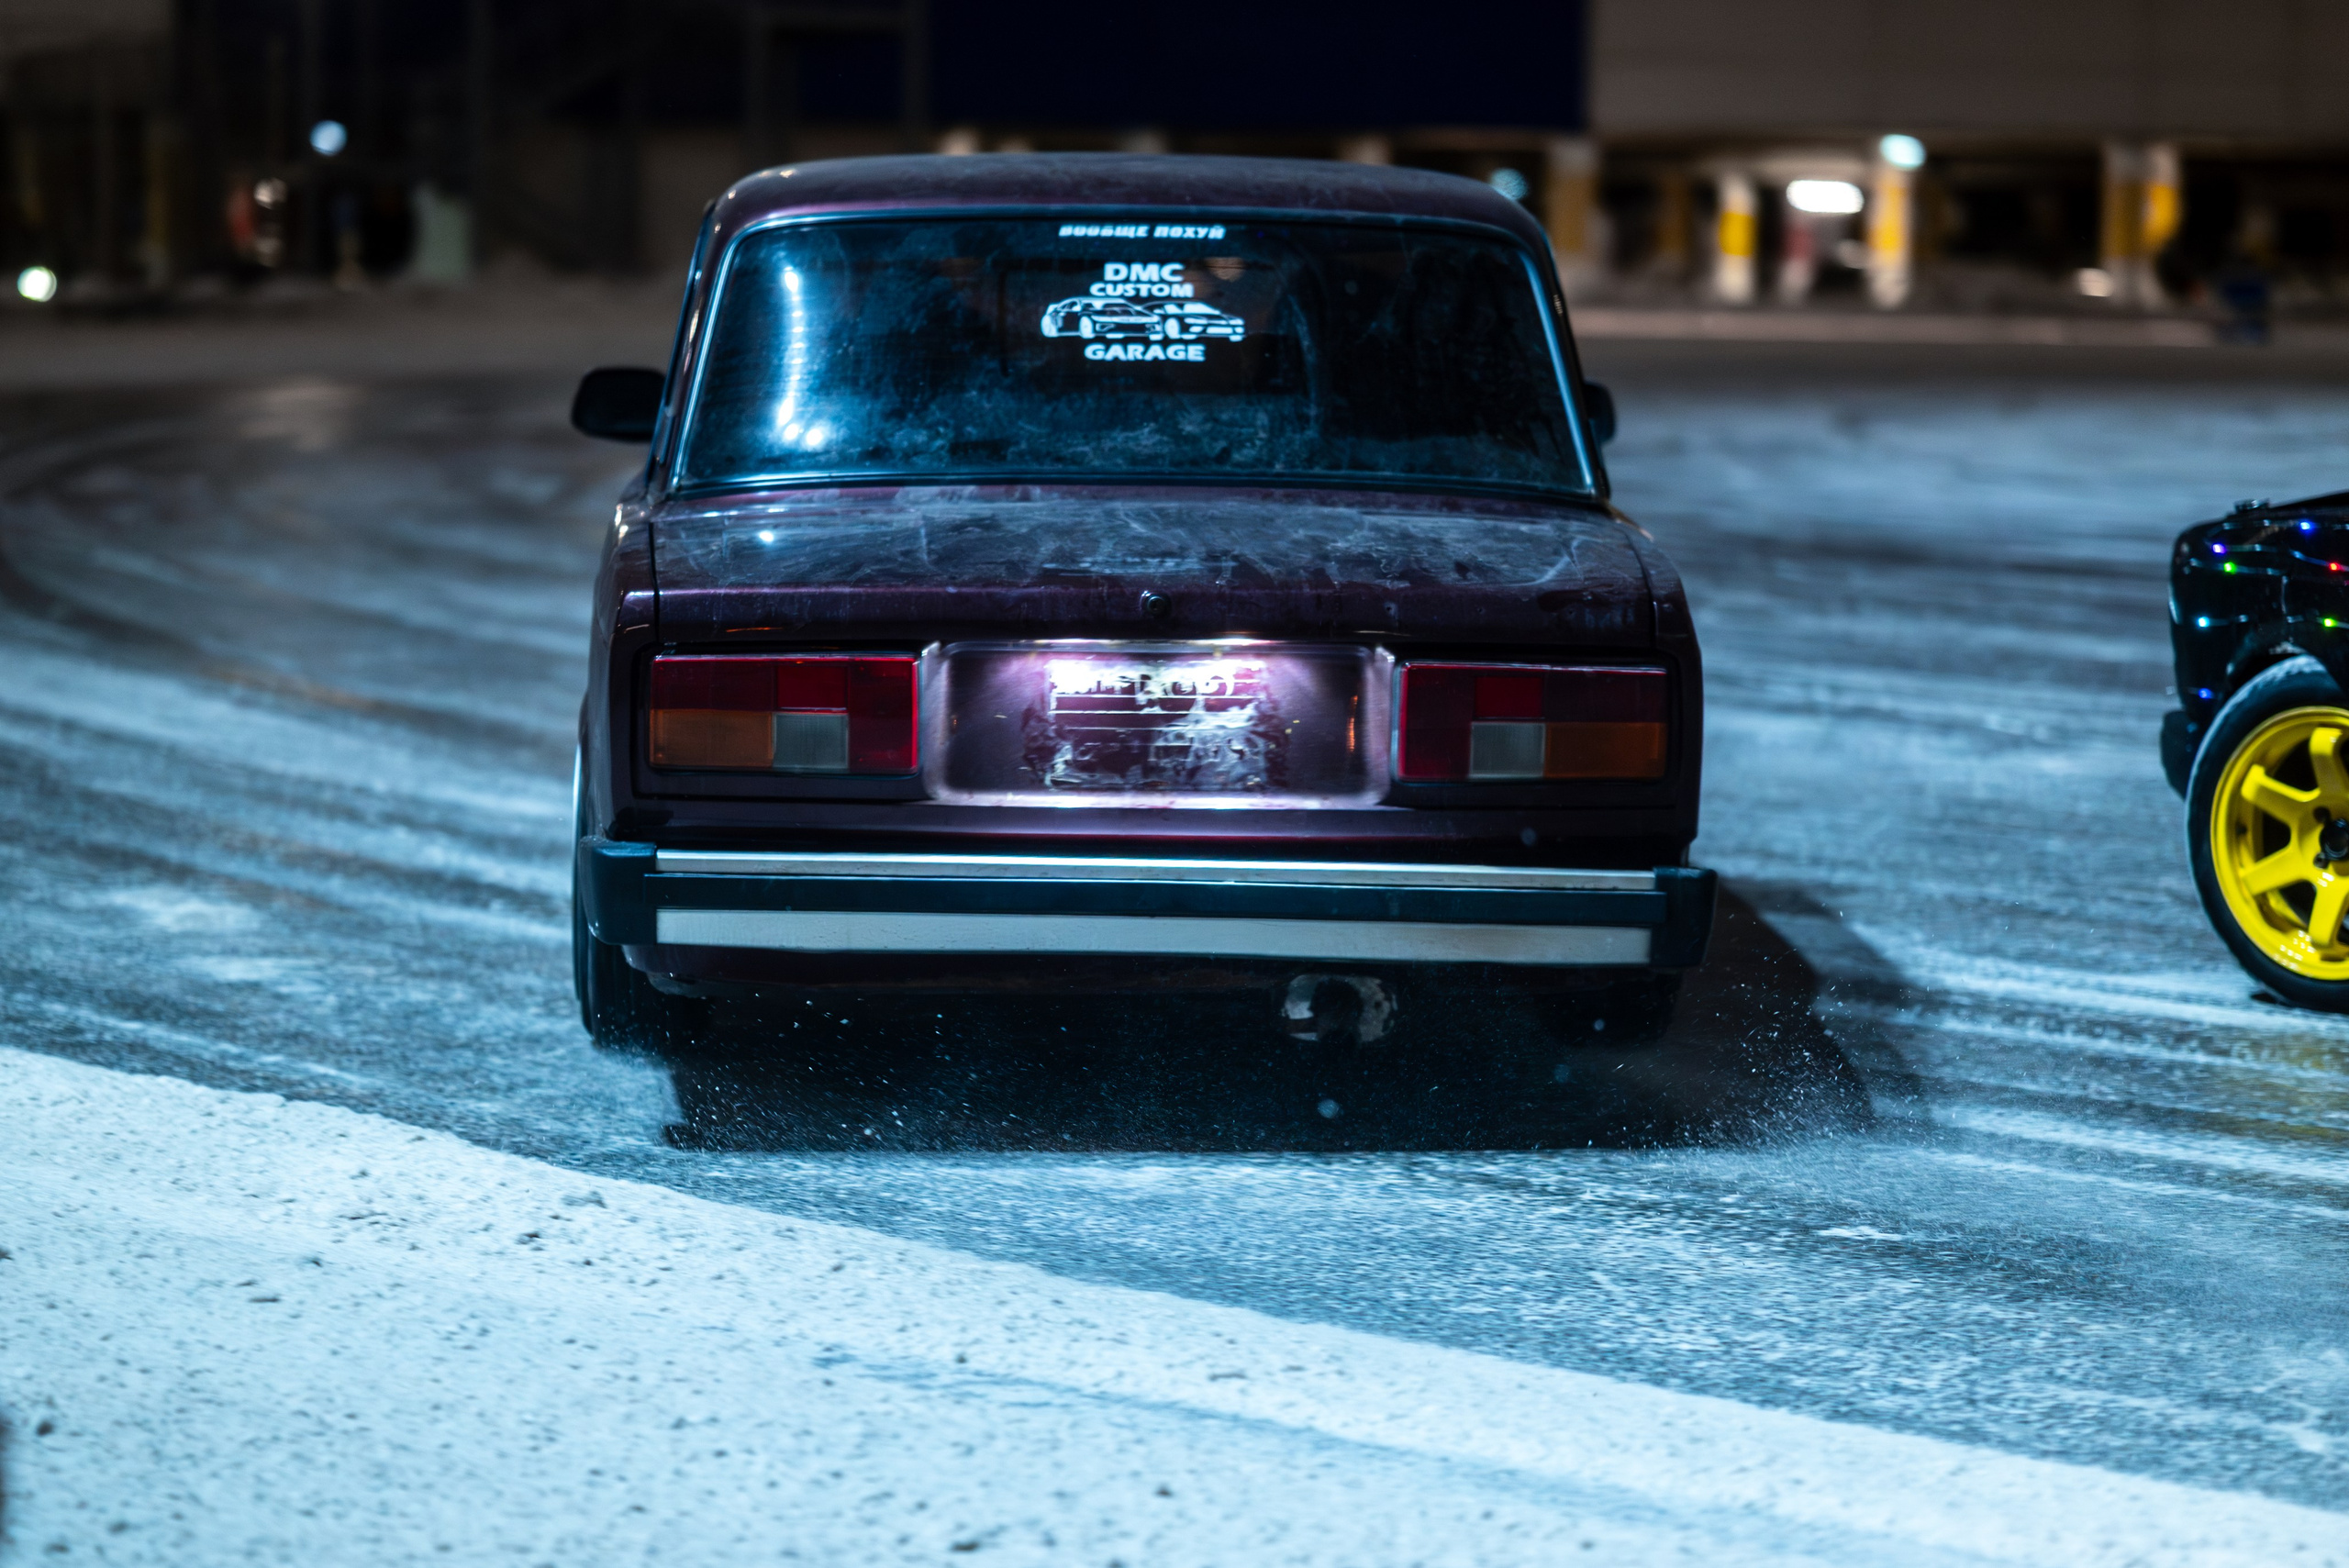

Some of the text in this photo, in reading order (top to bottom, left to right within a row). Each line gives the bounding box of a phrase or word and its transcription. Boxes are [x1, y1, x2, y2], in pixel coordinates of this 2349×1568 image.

[1104, 262, 1185, 282] DMC
[1089, 283, 1194, 298] CUSTOM
[1084, 343, 1207, 361] GARAGE
